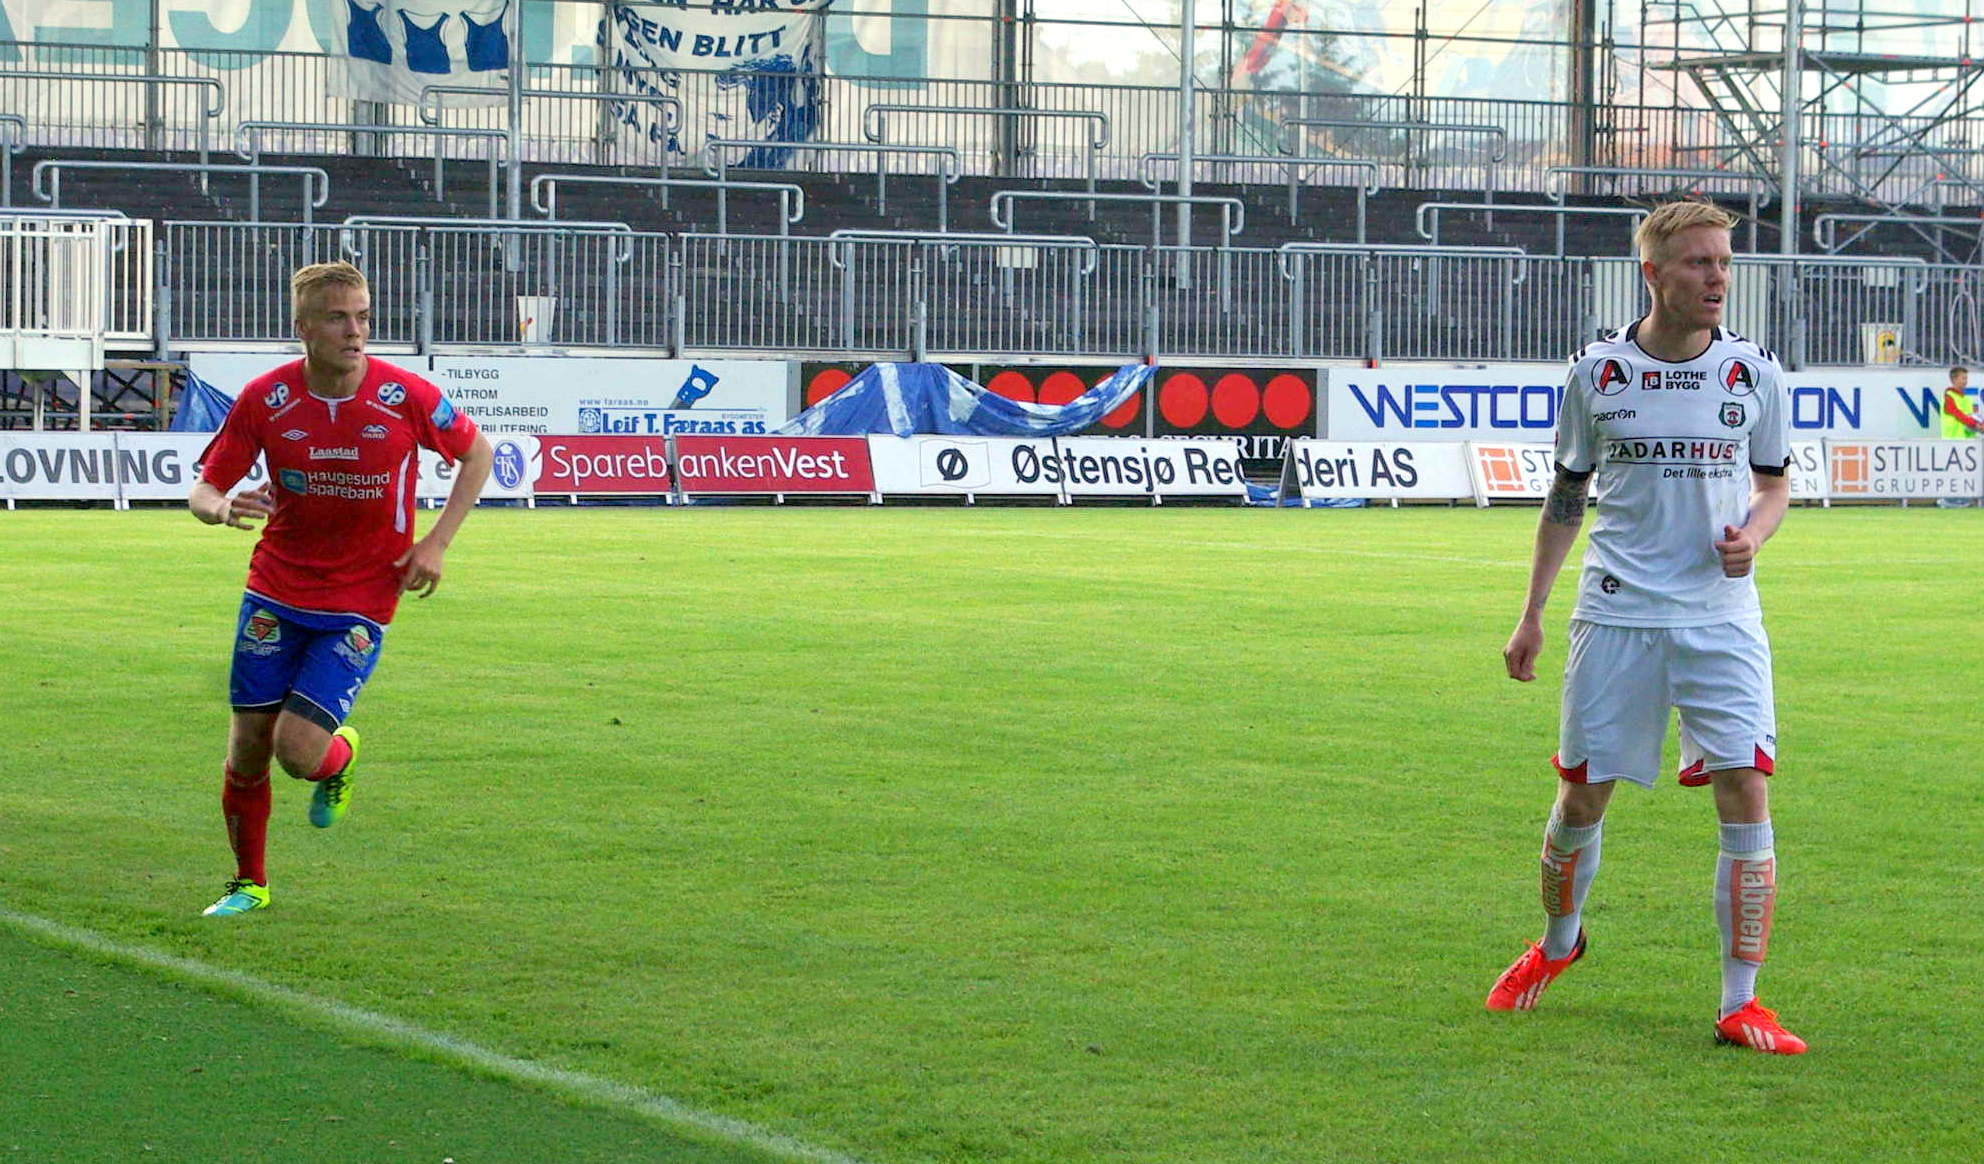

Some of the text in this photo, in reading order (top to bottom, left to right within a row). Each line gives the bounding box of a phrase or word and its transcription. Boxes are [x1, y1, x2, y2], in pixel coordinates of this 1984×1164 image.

[692, 26, 786, 58] BLITT
[1665, 370, 1707, 381] LOTHE
[1665, 380, 1700, 390] BYGG
[447, 386, 498, 400] VÅTROM
[602, 413, 639, 434] Leif
[742, 420, 766, 435] as
[0, 447, 182, 484] OVNING
[1874, 446, 1977, 472] STILLAS
[1012, 443, 1176, 492] Østensjø
[1371, 448, 1418, 488] AS
[1663, 468, 1684, 479] Det
[307, 471, 390, 486] Haugesund
[1873, 478, 1976, 493] GRUPPEN
